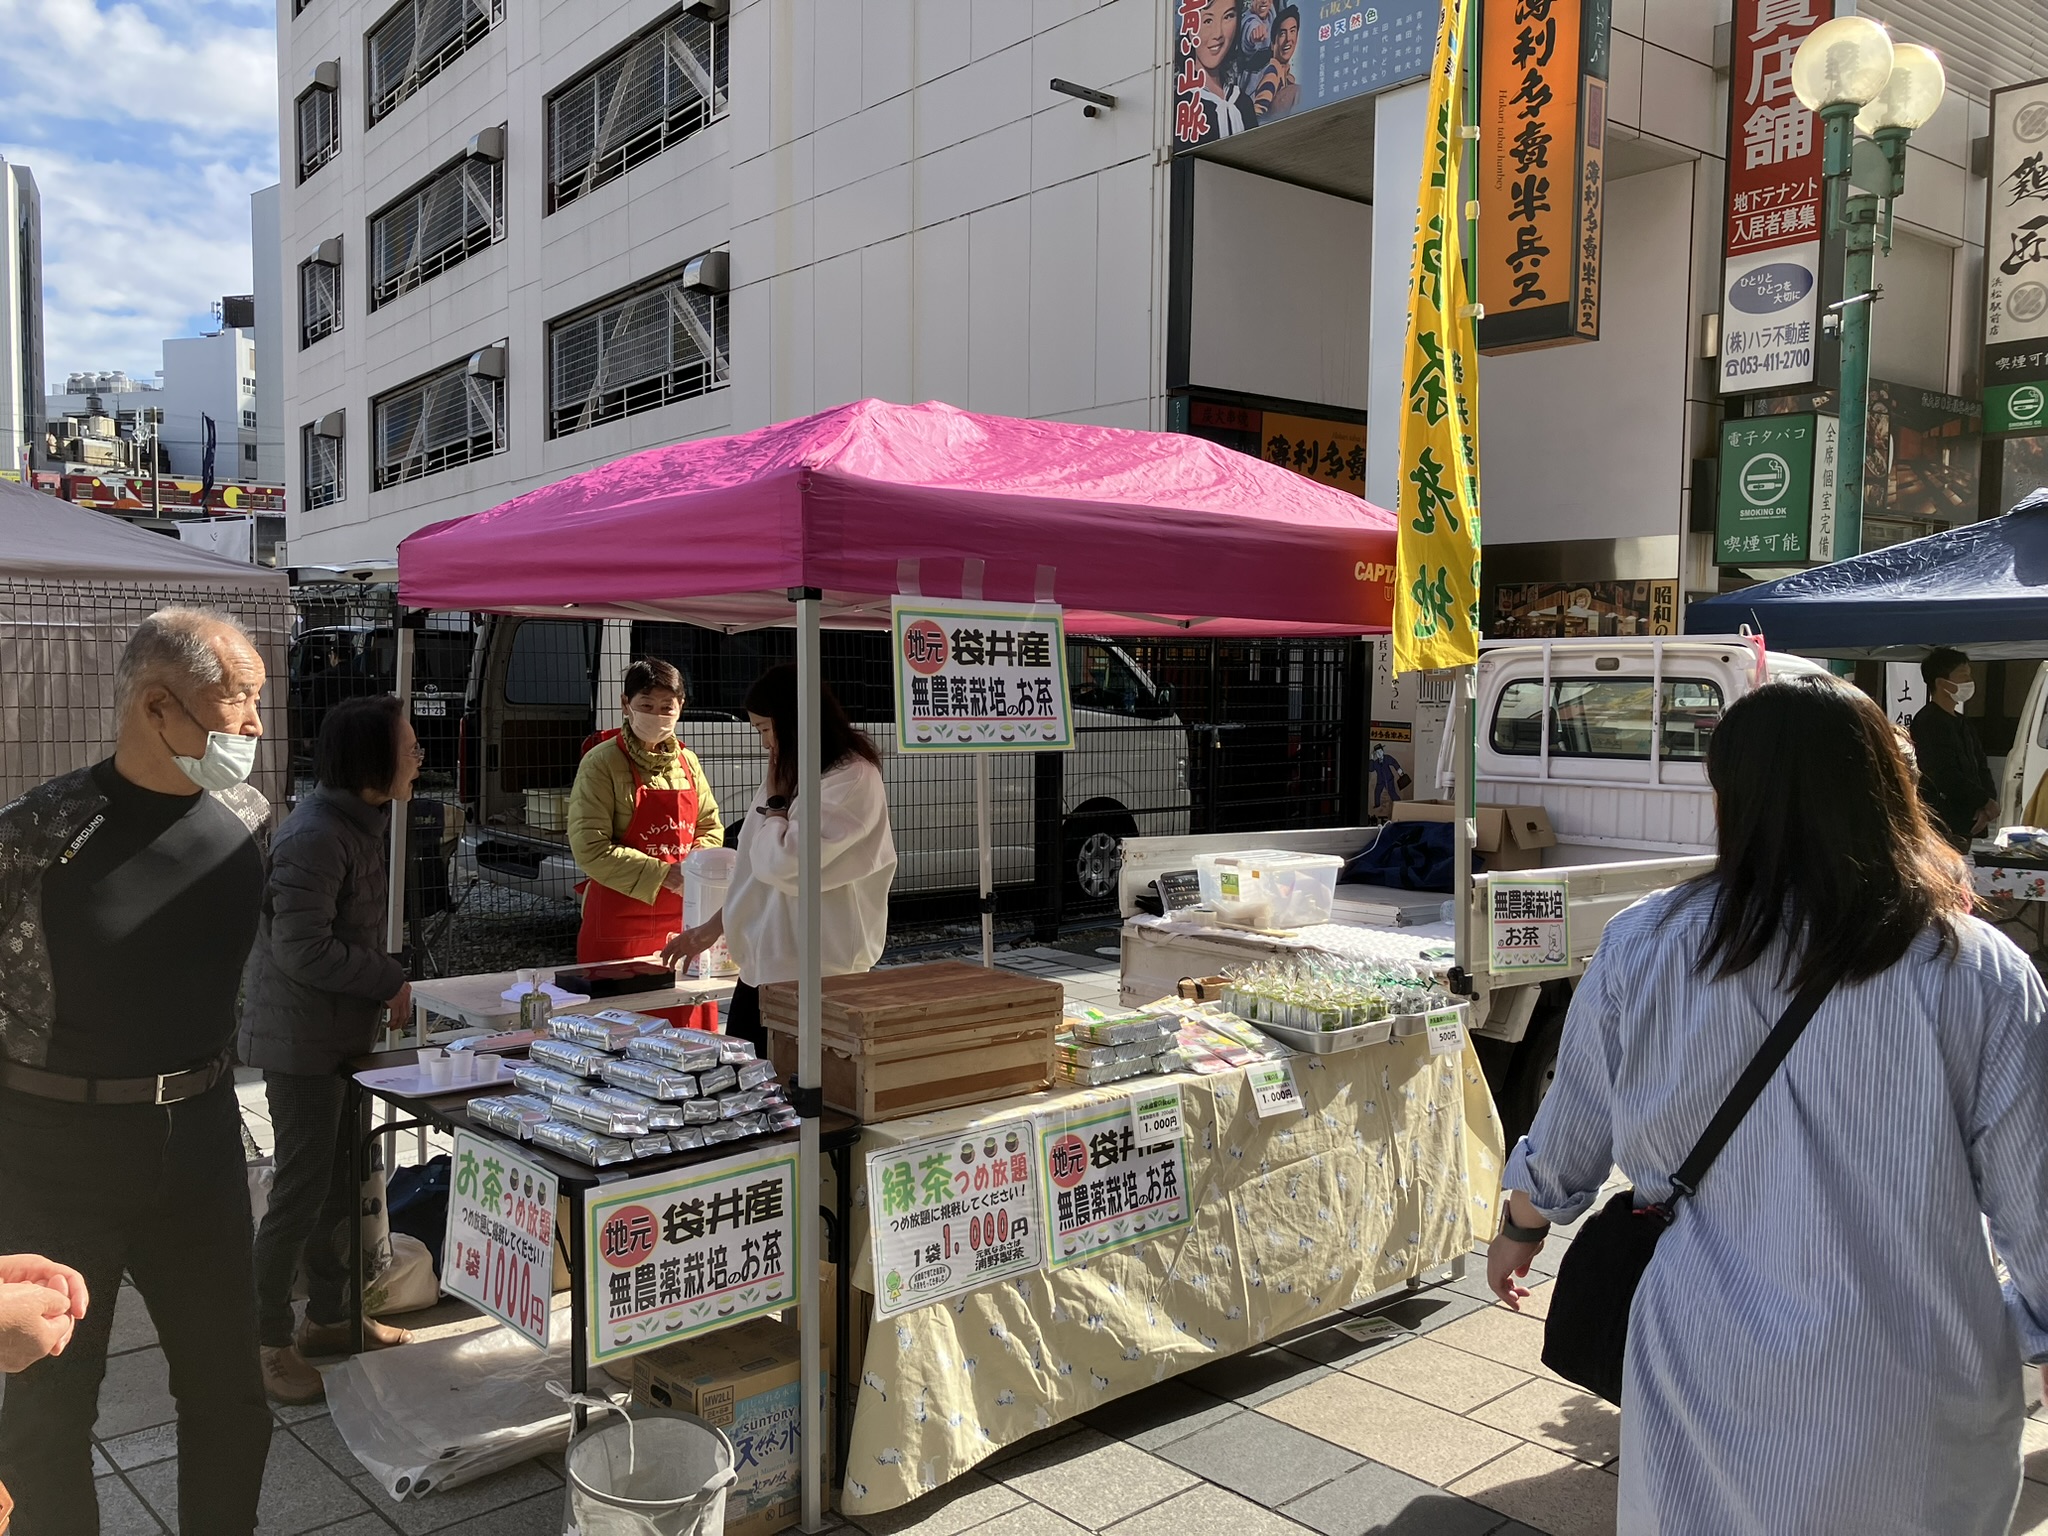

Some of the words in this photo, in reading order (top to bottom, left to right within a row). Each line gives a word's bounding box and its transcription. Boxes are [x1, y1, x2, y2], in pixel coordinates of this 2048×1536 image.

[1319, 8, 1378, 41] 総天然色
[1405, 14, 1413, 70] 浜田光夫
[1415, 11, 1423, 67] 吉永小百合
[1176, 0, 1210, 142] 青い山脈
[1734, 177, 1818, 212] 地下テナント
[1732, 204, 1816, 243] 入居者募集
[1740, 273, 1772, 287] ひとりと
[1758, 281, 1792, 295] ひとつを
[1774, 291, 1800, 304] 大切に
[1990, 278, 2002, 336] 浜松駅前店
[1740, 348, 1810, 375] 053-411-2700
[1728, 428, 1806, 448] 電子タバコ
[1819, 422, 1836, 557] 全席個室完備
[1740, 508, 1774, 517] SMOKING
[1776, 507, 1787, 515] OK
[1724, 533, 1800, 553] 喫煙可能
[1653, 586, 1672, 636] 昭和の
[908, 630, 944, 662] 地元
[951, 628, 1051, 667] 袋井産
[912, 675, 1053, 716] 無農薬栽培のお茶
[1494, 890, 1562, 919] 無農薬栽培
[1498, 926, 1539, 946] のお茶
[1440, 1030, 1456, 1042] 500円
[1052, 1142, 1086, 1179] 地元
[457, 1150, 504, 1216] お茶
[504, 1192, 551, 1247] つめ放題
[880, 1152, 954, 1216] 緑茶
[954, 1152, 1028, 1195] つめ放題
[1058, 1159, 1178, 1231] 無農薬栽培のお茶
[606, 1216, 653, 1258] 地元
[662, 1178, 784, 1245] 袋井産
[890, 1184, 1026, 1233] つめ放題に挑戦してください！
[609, 1230, 782, 1319] 無農薬栽培のお茶
[914, 1245, 941, 1267] 1袋
[975, 1247, 1025, 1271] 浦野製茶
[456, 1242, 480, 1280] 1袋
[483, 1238, 544, 1337] 1000円
[743, 1407, 795, 1433] SUNTORY
[734, 1421, 801, 1472] 天然水
